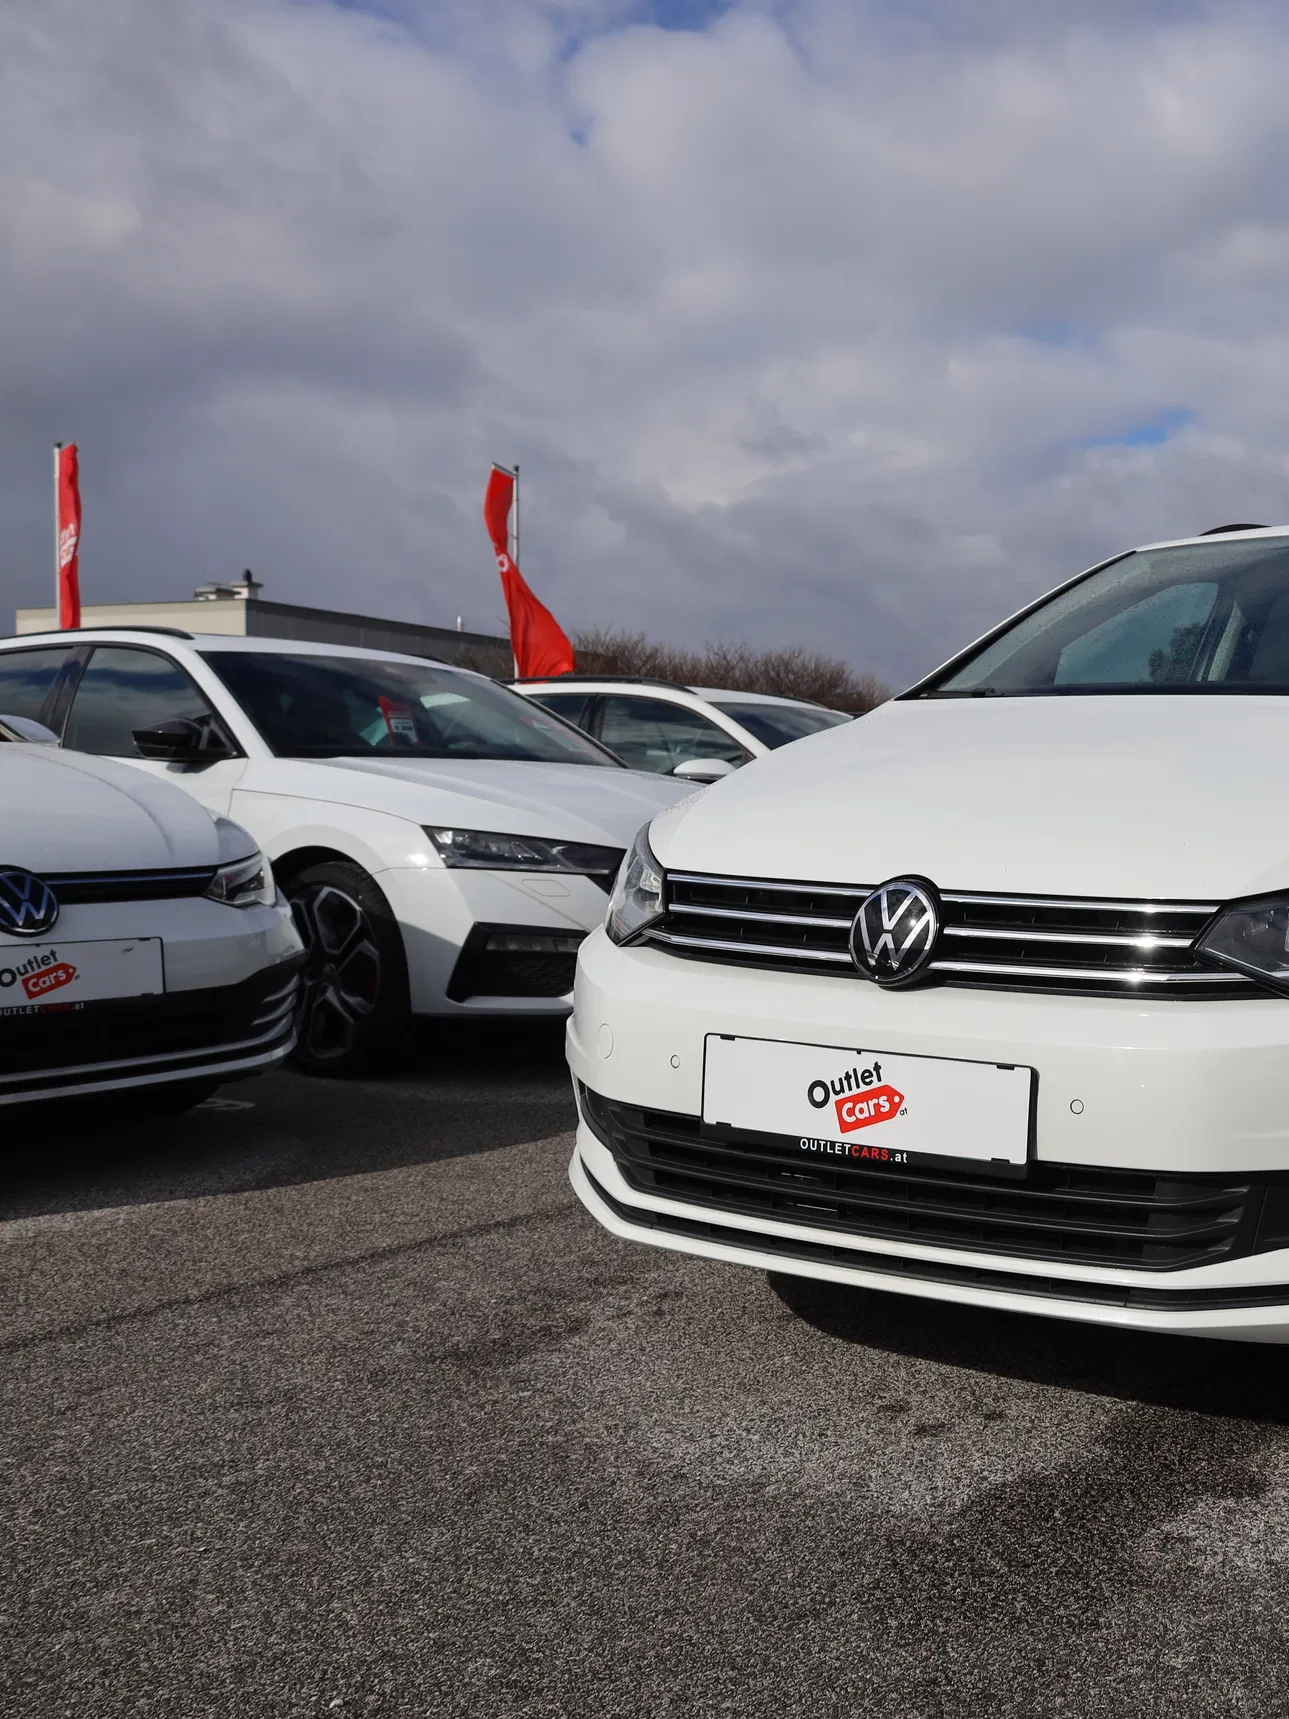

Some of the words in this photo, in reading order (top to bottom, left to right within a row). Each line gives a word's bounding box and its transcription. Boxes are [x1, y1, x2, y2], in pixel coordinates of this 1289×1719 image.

[0, 949, 58, 987] Outlet
[28, 969, 67, 992] Cars
[807, 1061, 882, 1109] Outlet
[841, 1095, 890, 1123] Cars
[800, 1138, 908, 1163] OUTLETCARS.at
